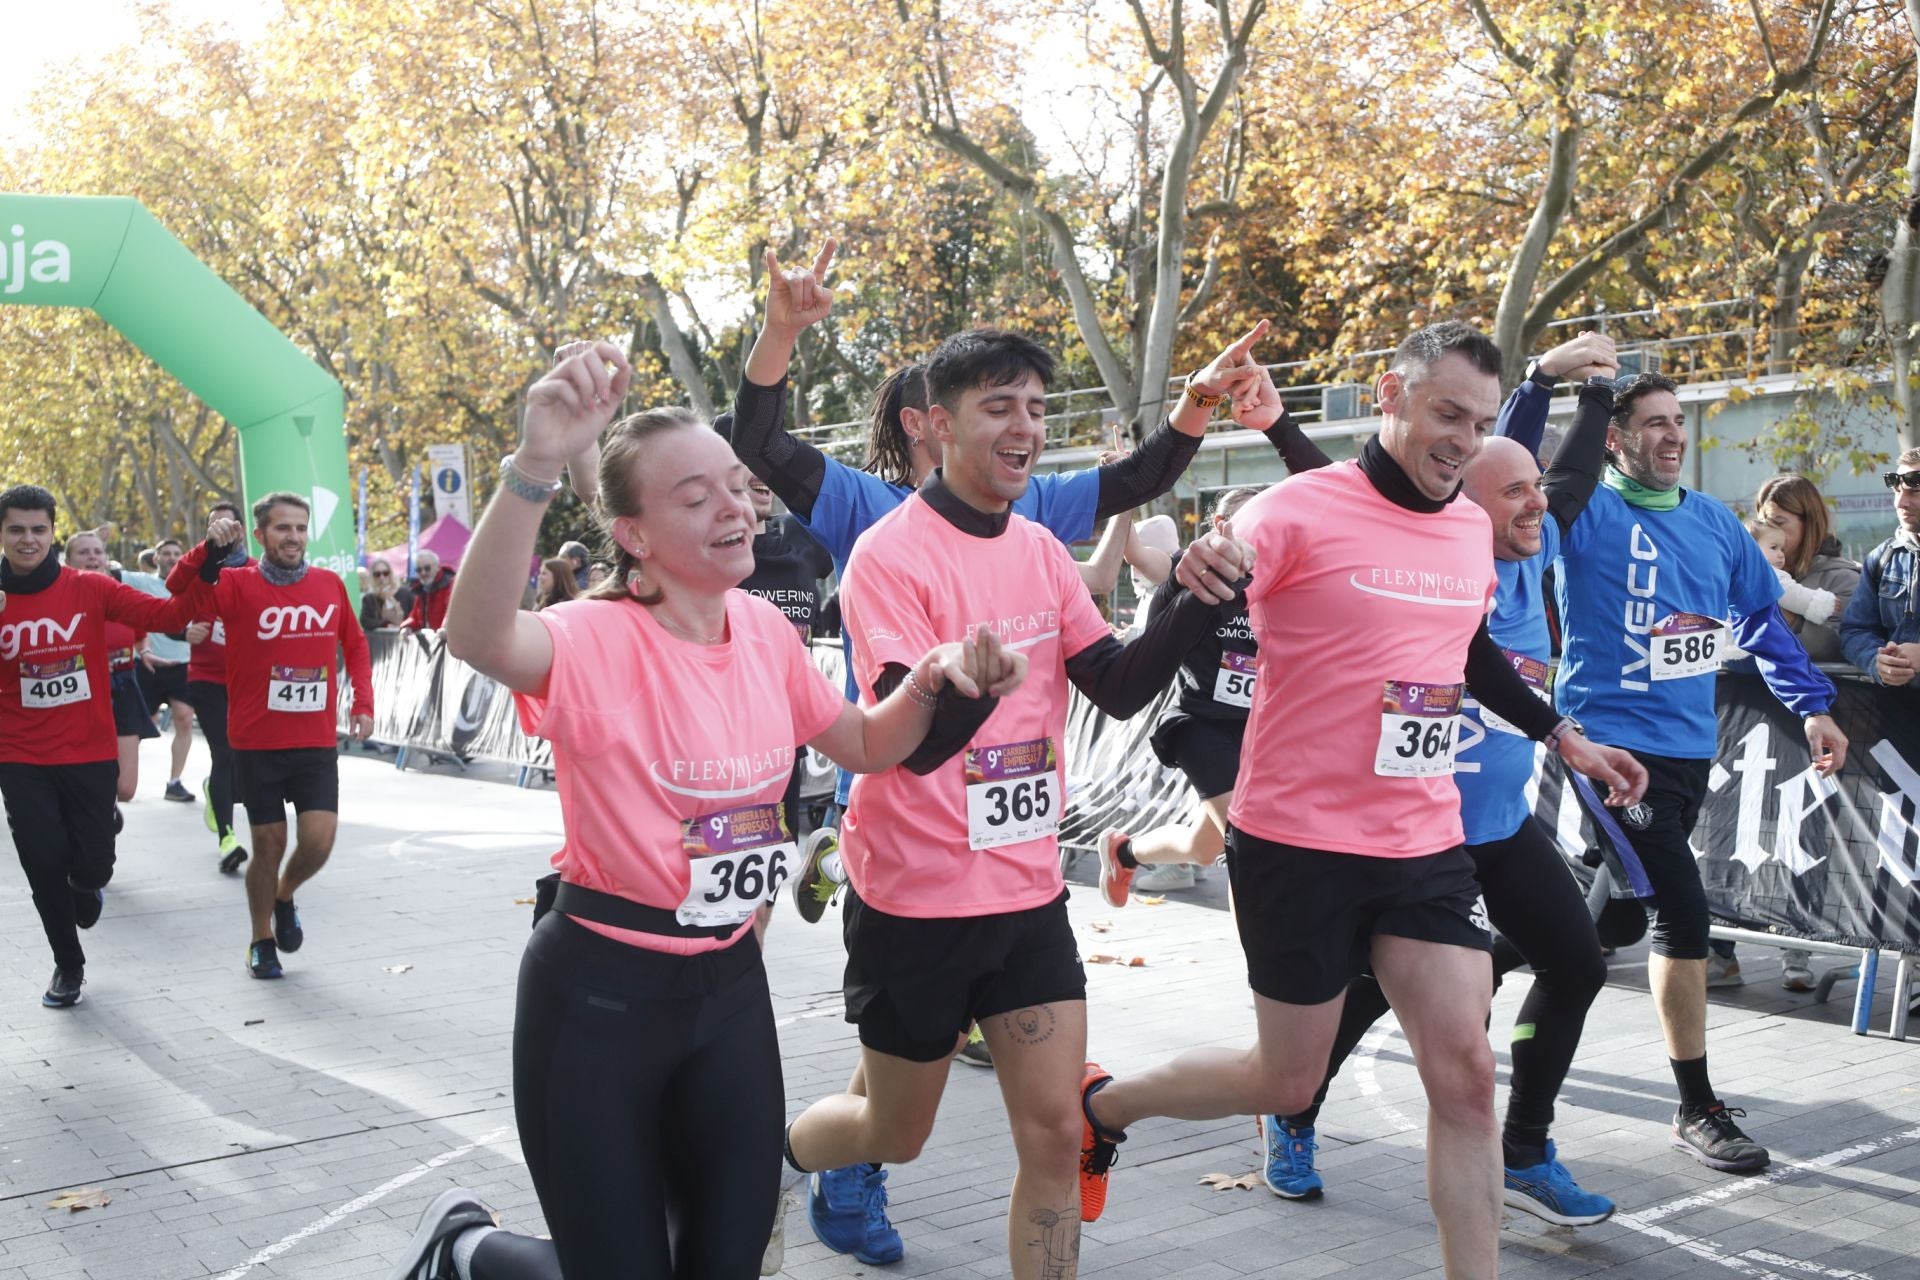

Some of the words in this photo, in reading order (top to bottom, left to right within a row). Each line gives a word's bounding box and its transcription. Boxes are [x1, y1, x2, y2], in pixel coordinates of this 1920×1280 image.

[0, 223, 71, 294] ja
[258, 604, 336, 640] gmv
[1620, 523, 1658, 692] IVECO
[0, 612, 82, 660] gmv
[1663, 633, 1715, 665] 586
[30, 676, 78, 698] 409
[278, 684, 318, 702] 411
[1395, 721, 1453, 759] 364
[985, 778, 1050, 826] 365
[704, 850, 789, 903] 366
